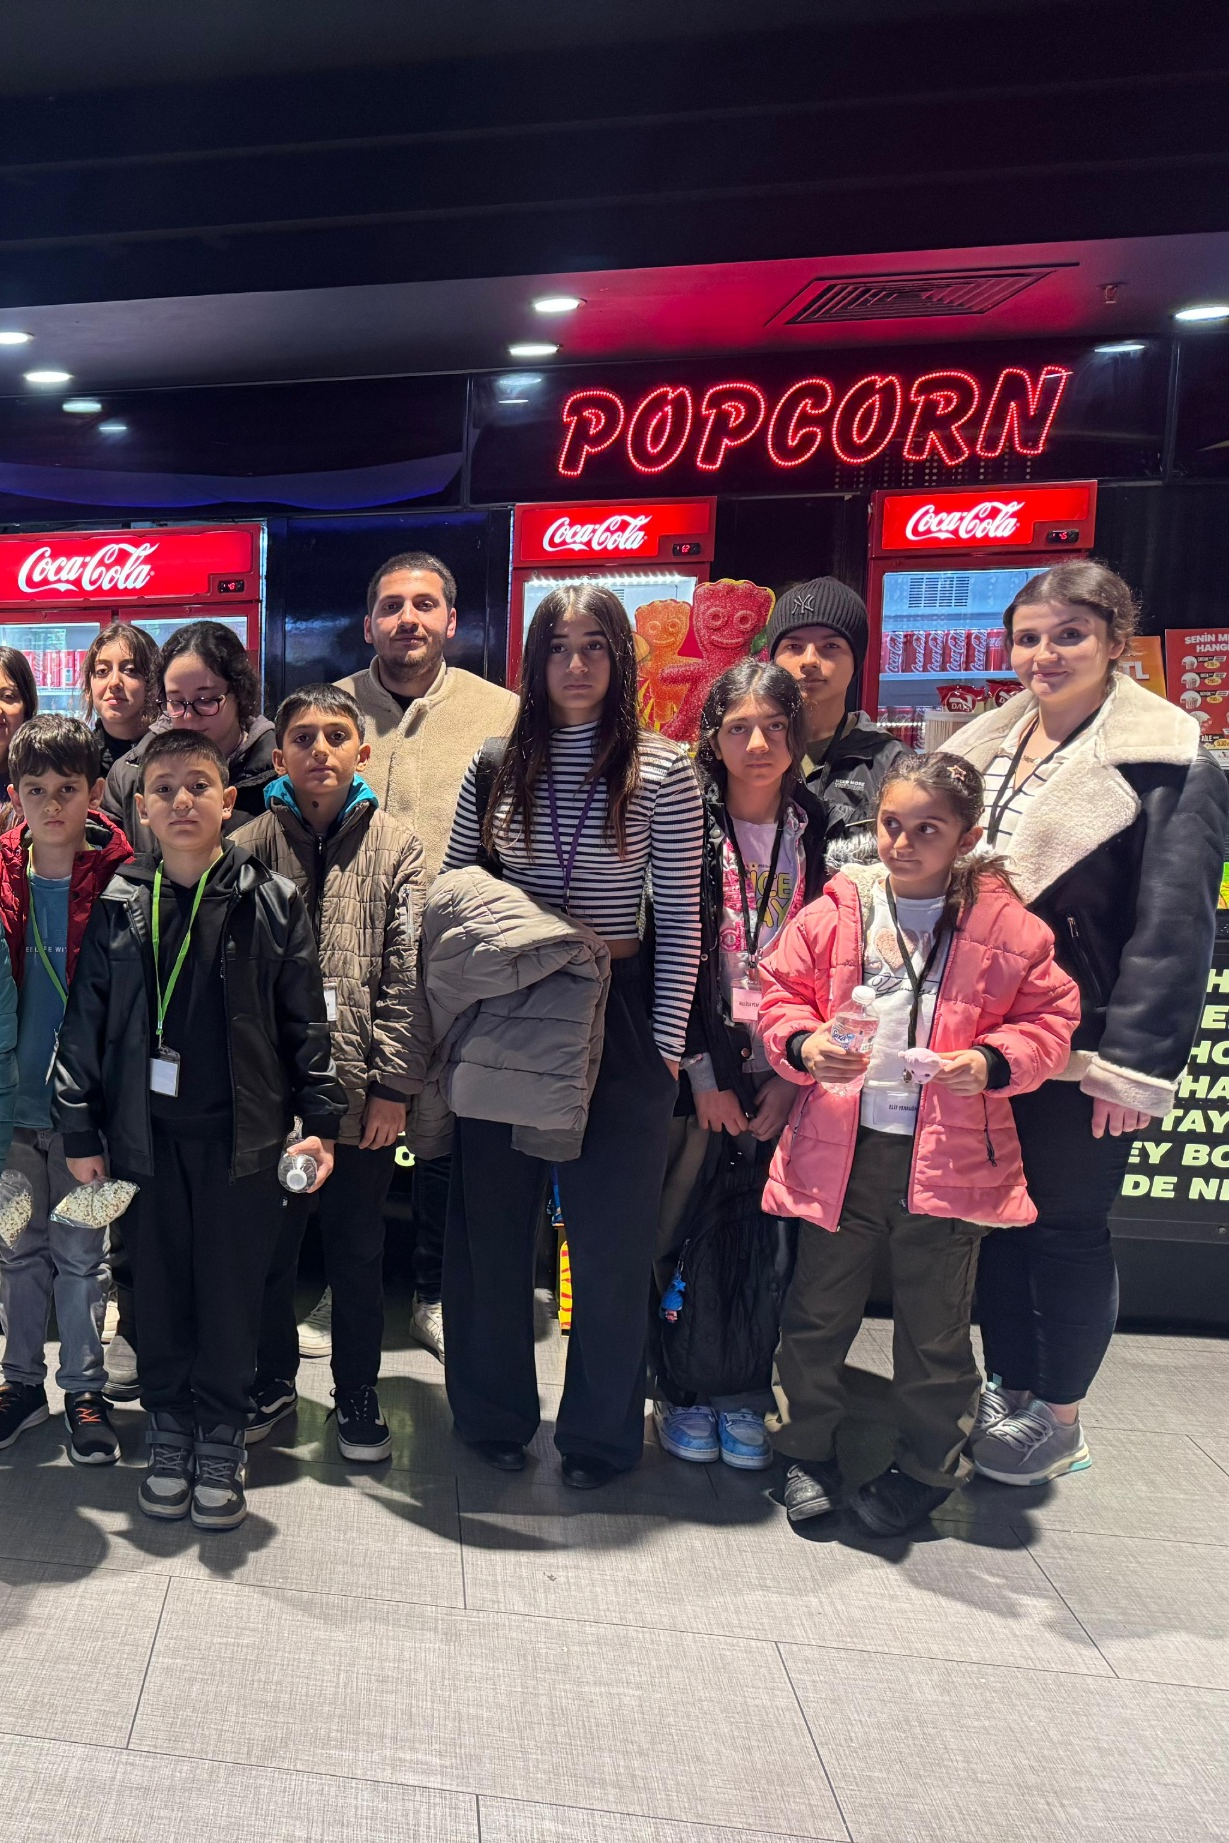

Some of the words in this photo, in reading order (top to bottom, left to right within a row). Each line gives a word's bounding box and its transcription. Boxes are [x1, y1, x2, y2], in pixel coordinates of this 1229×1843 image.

[557, 365, 1069, 476] POPCORN
[543, 514, 653, 552] Coca-Cola
[905, 501, 1026, 541] Coca-Cola
[18, 542, 160, 593] Coca-Cola
[1184, 632, 1216, 645] SENİN
[1218, 633, 1229, 642] M
[1121, 1173, 1178, 1199] DE
